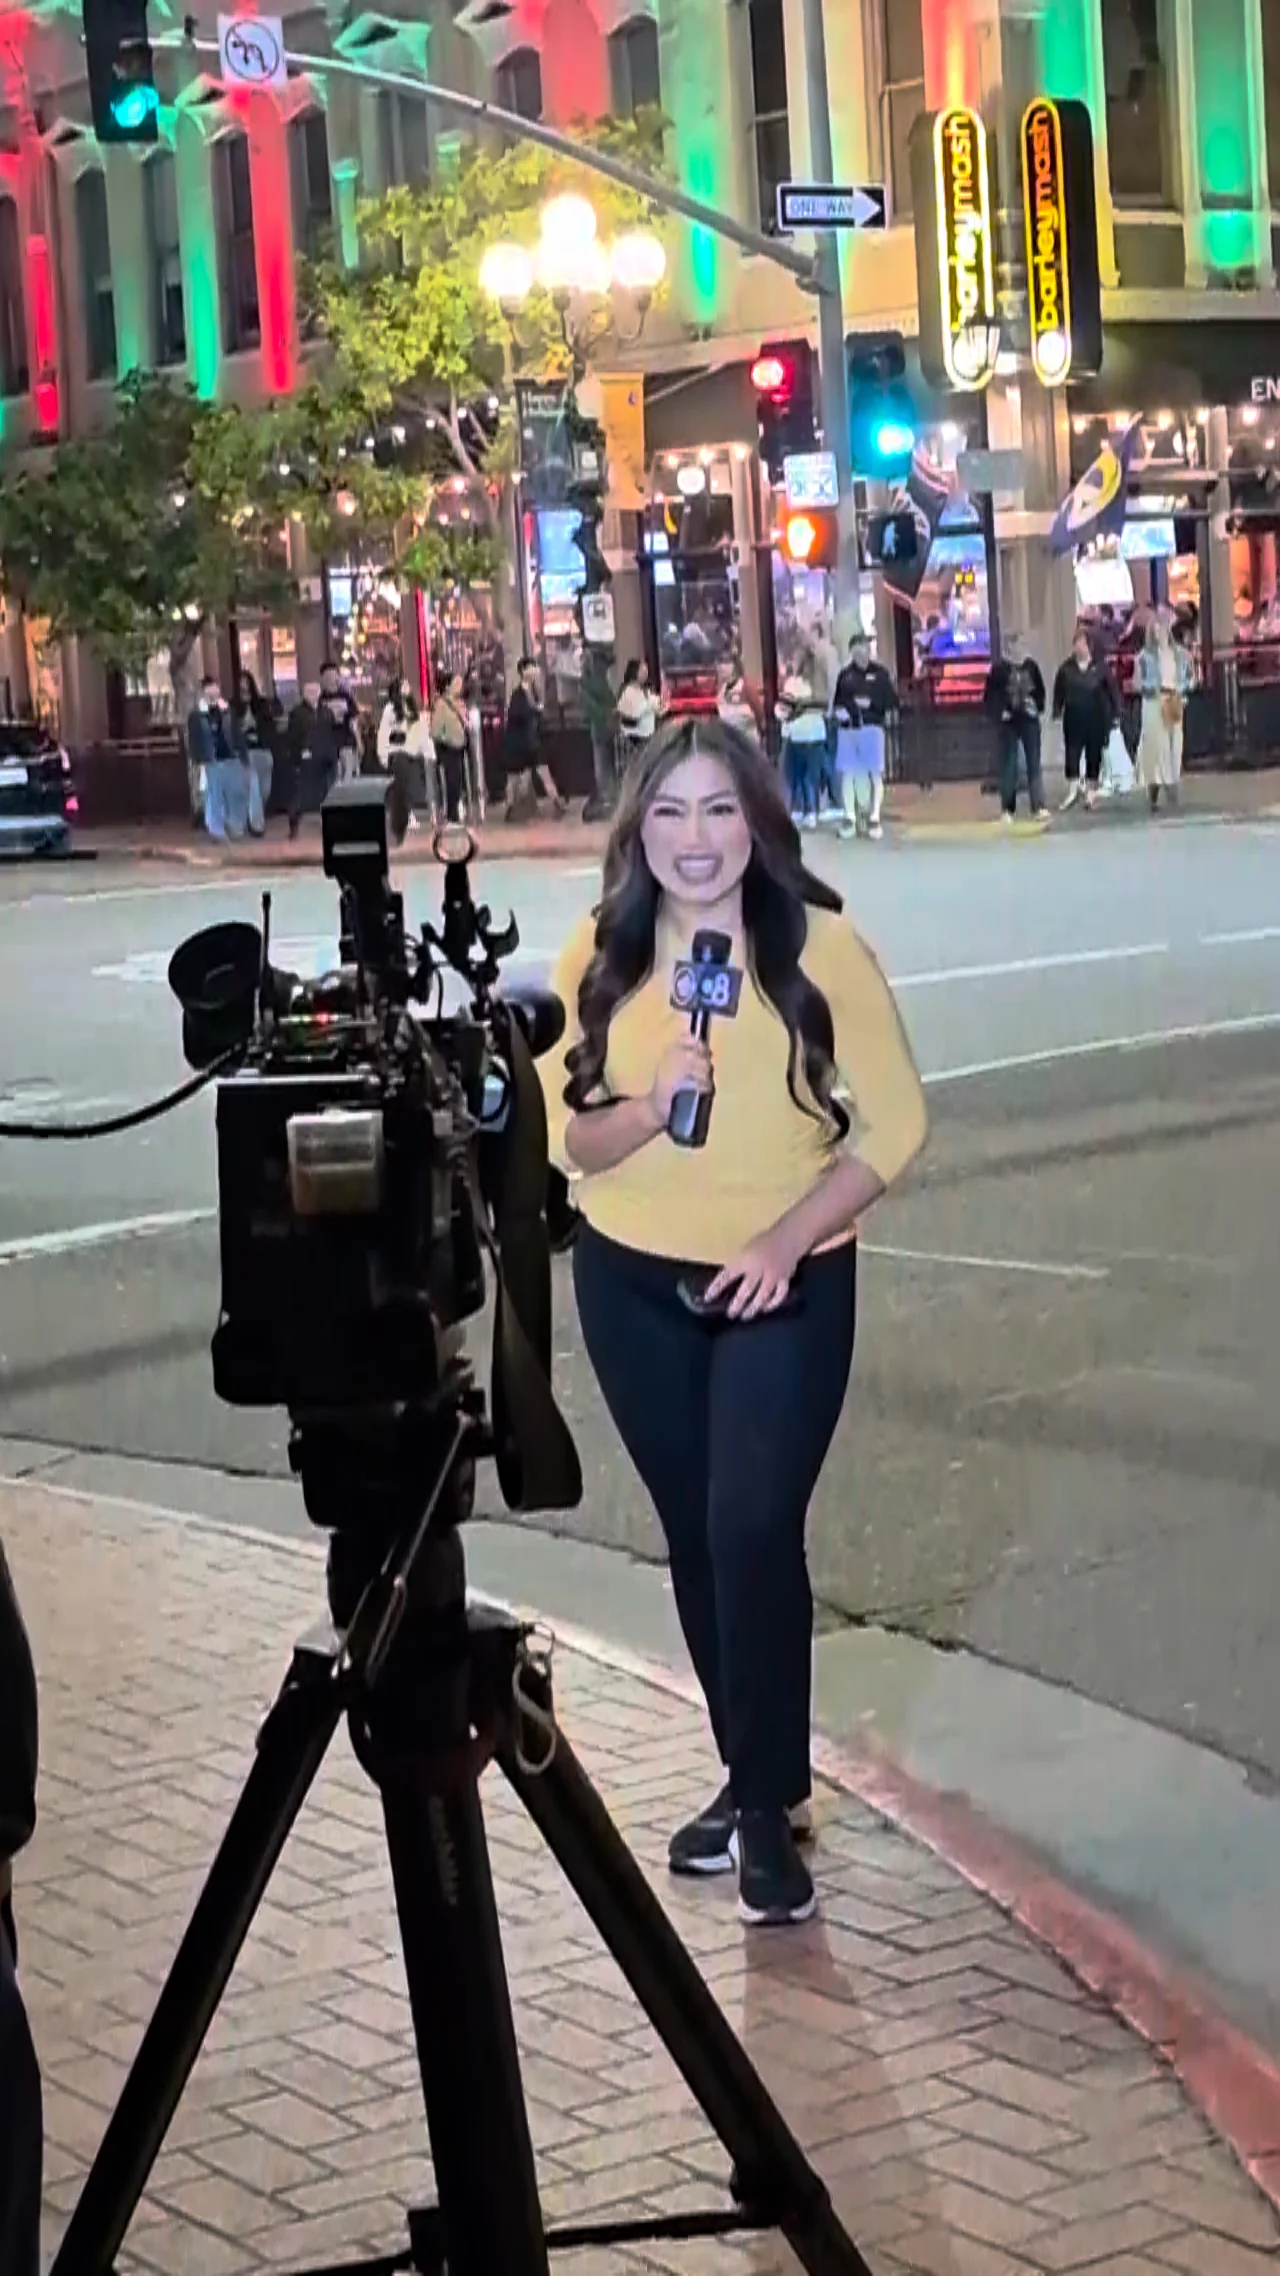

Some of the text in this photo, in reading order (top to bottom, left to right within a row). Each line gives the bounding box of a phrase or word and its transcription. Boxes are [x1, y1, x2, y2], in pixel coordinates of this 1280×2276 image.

[790, 198, 853, 217] ONE WAY
[1029, 111, 1059, 332] barleymash
